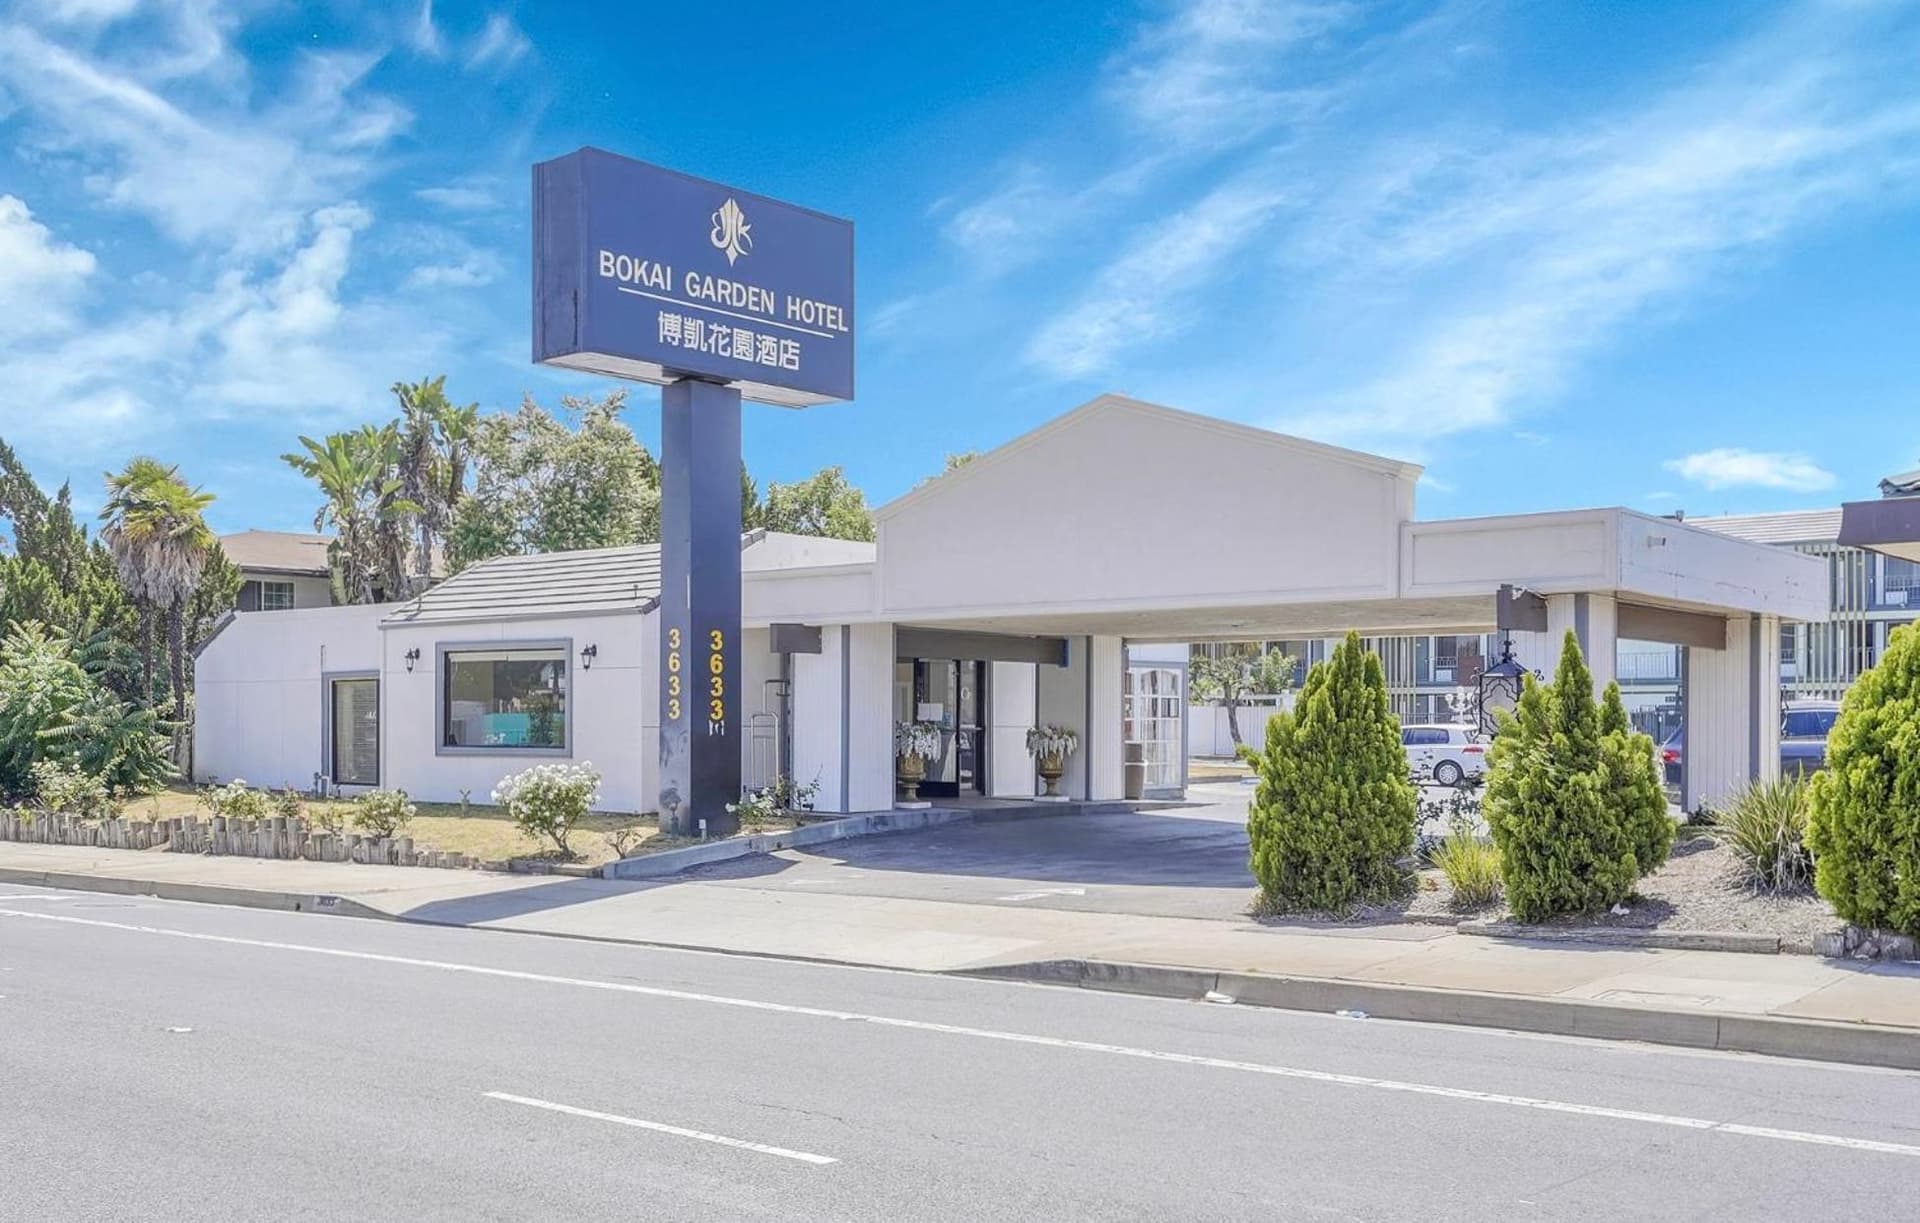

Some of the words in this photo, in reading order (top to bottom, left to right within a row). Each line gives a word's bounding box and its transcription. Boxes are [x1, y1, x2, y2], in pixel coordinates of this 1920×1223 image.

[600, 250, 671, 291] BOKAI
[685, 271, 774, 315] GARDEN
[787, 295, 849, 332] HOTEL
[658, 310, 800, 370] 博凱花園酒店
[668, 628, 681, 720] 3633
[710, 630, 723, 720] 3633
